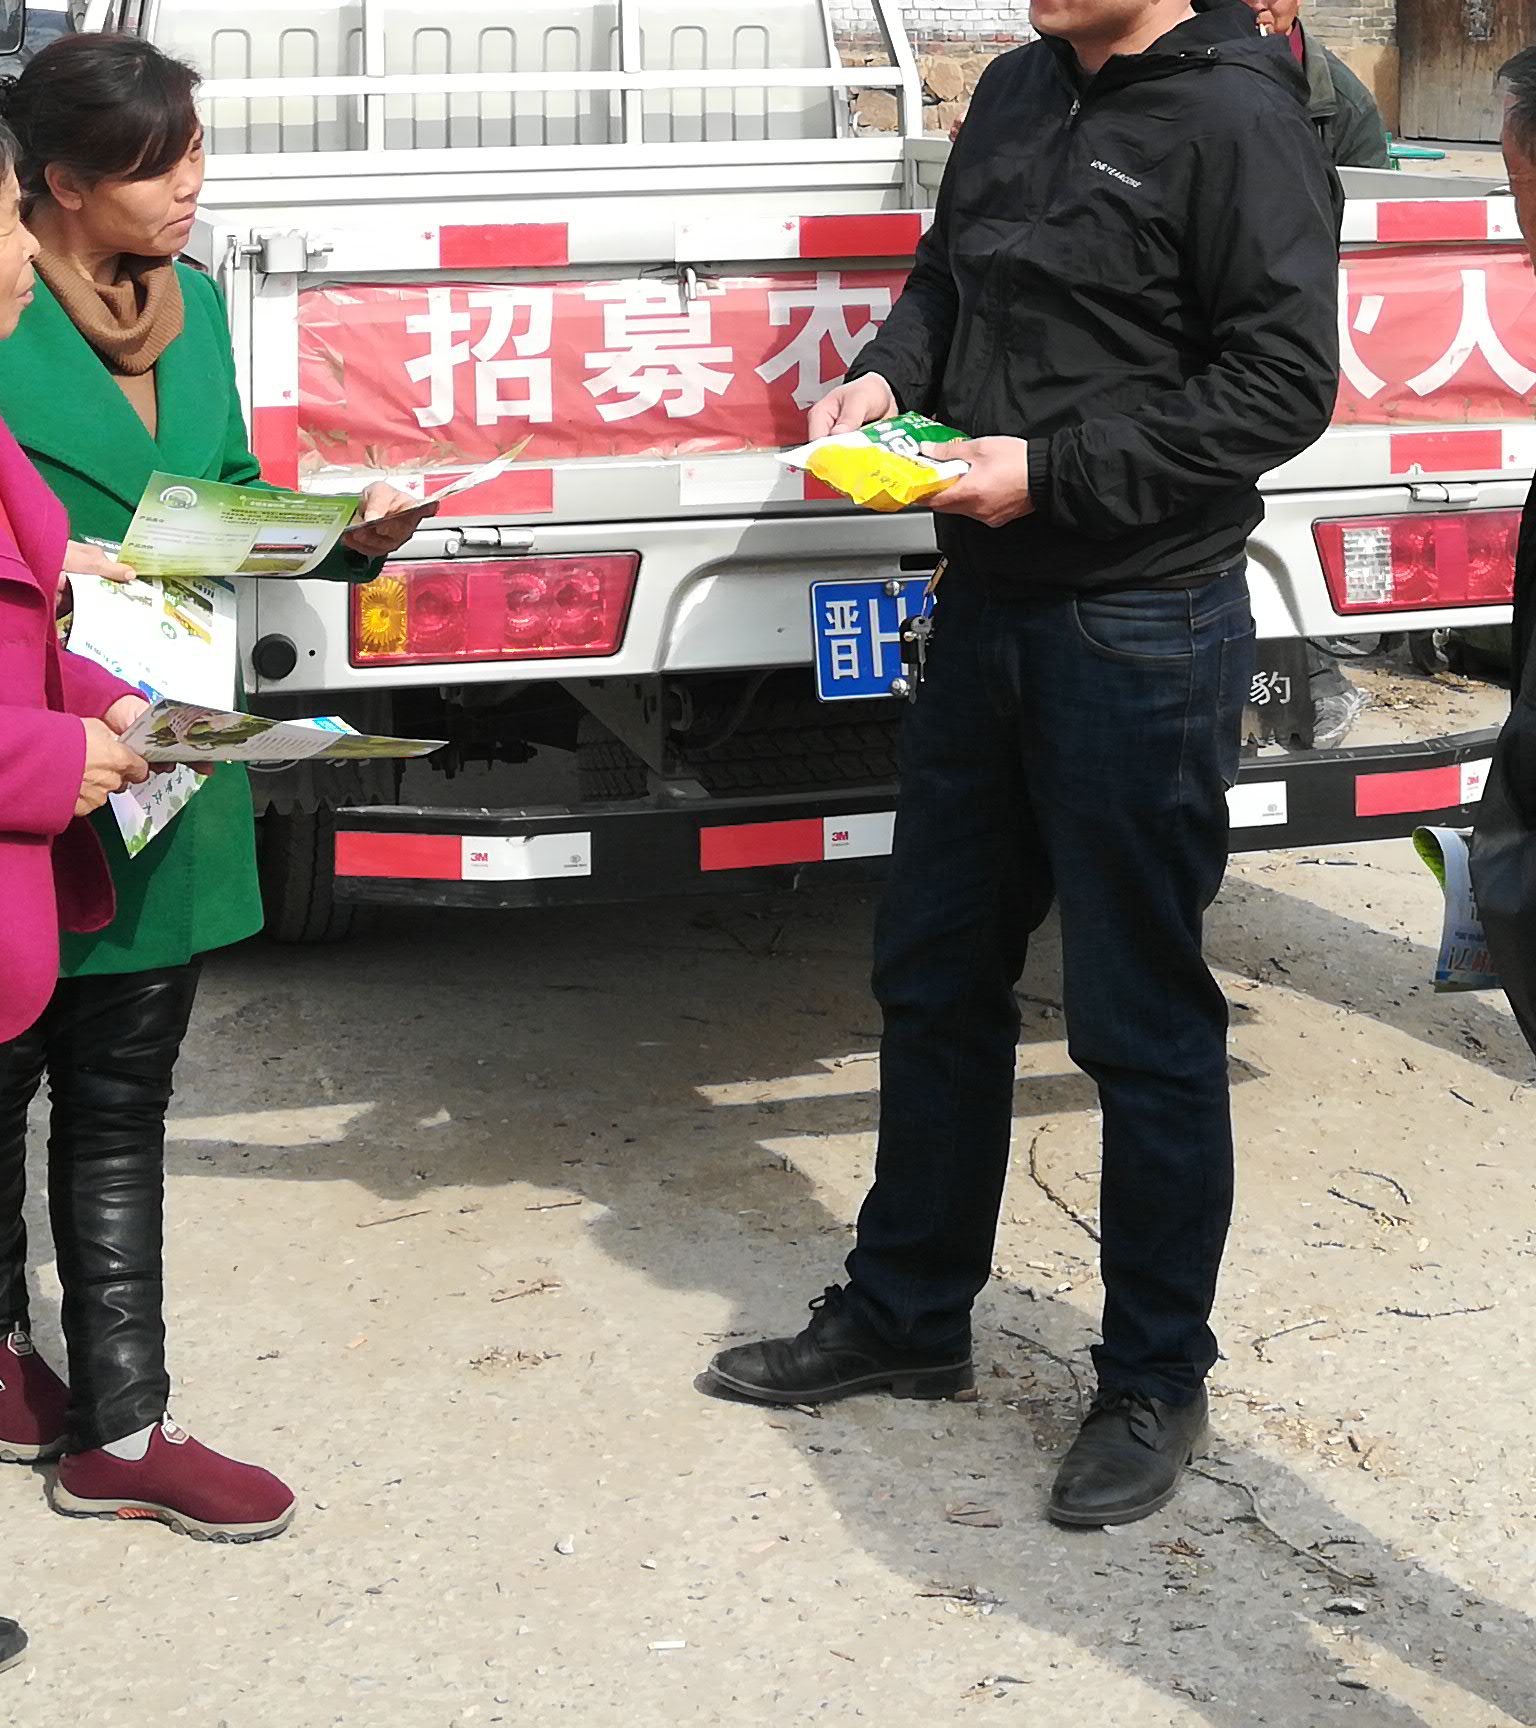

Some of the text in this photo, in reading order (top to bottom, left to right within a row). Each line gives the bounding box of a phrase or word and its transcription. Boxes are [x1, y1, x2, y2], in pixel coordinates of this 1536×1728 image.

[1249, 671, 1291, 706] 豹
[1467, 775, 1480, 786] 3M
[831, 830, 849, 842] 3M
[470, 852, 489, 862] 3M
